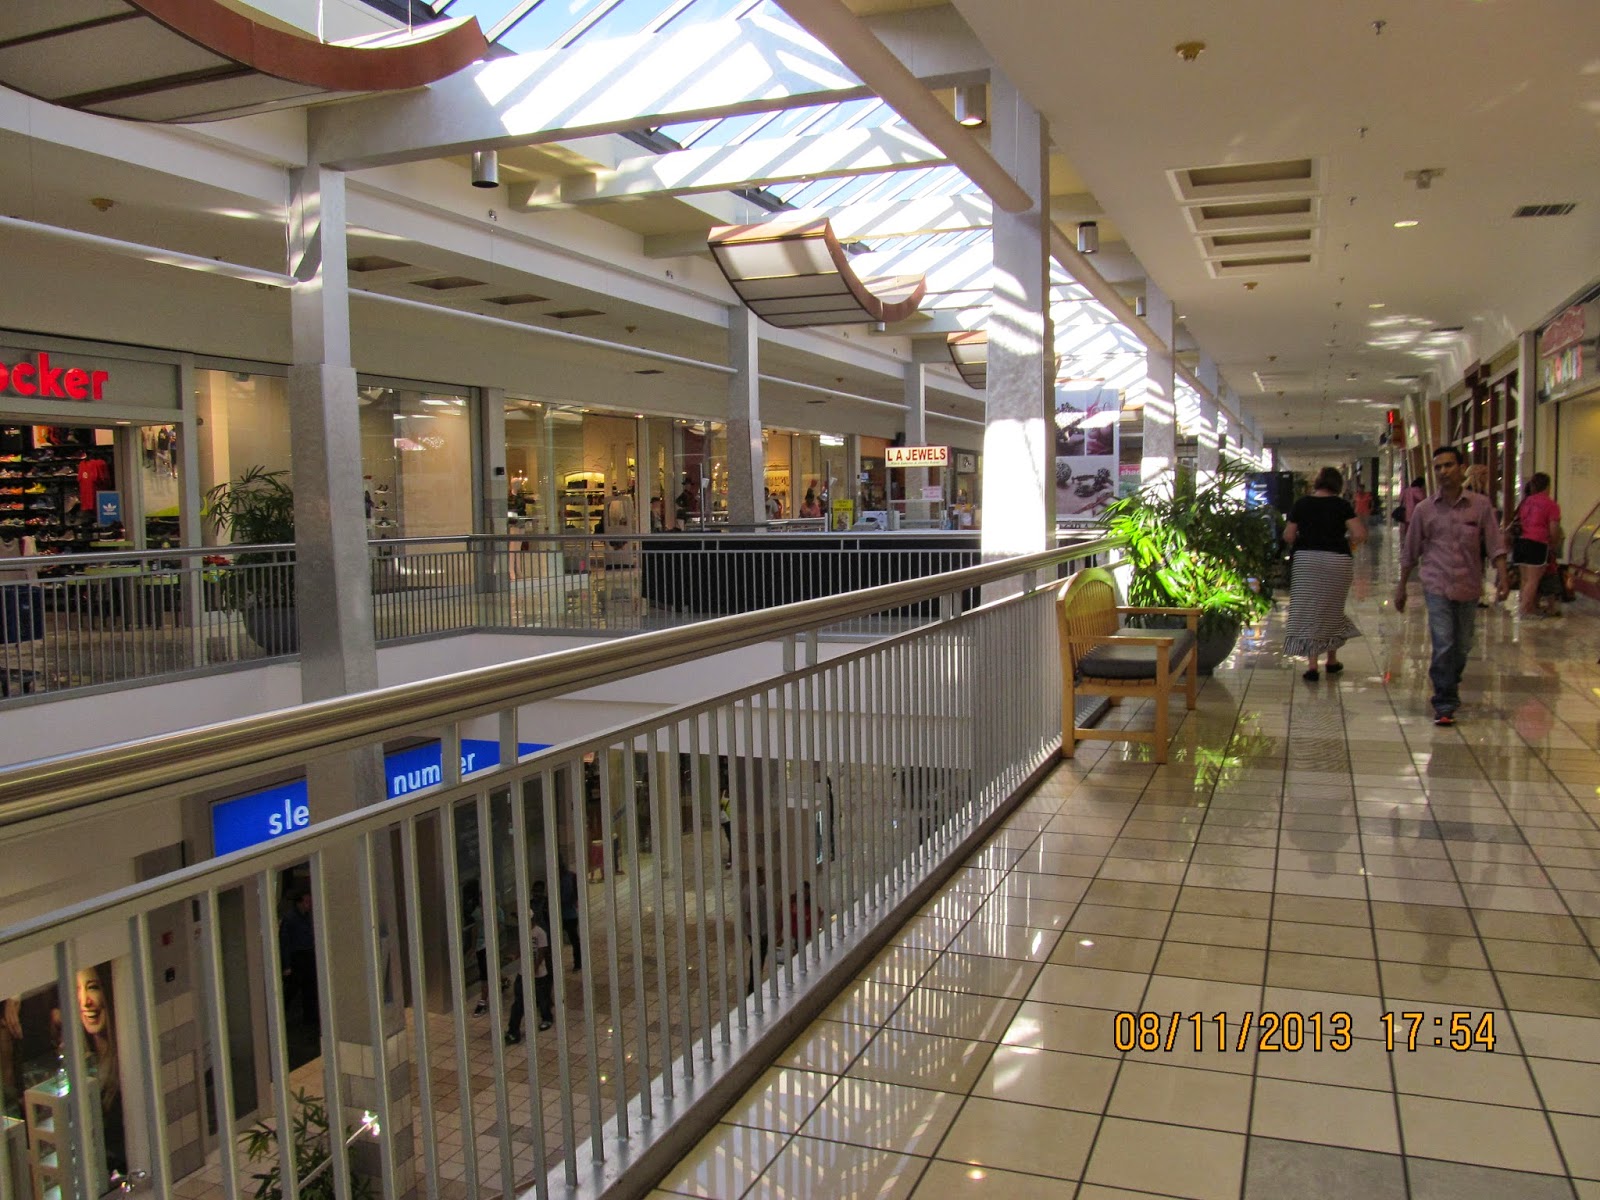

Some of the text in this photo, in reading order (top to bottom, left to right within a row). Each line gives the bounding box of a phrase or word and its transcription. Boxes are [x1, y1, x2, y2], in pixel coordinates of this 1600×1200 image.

[887, 448, 946, 461] L A JEWELS
[393, 752, 476, 795] numer
